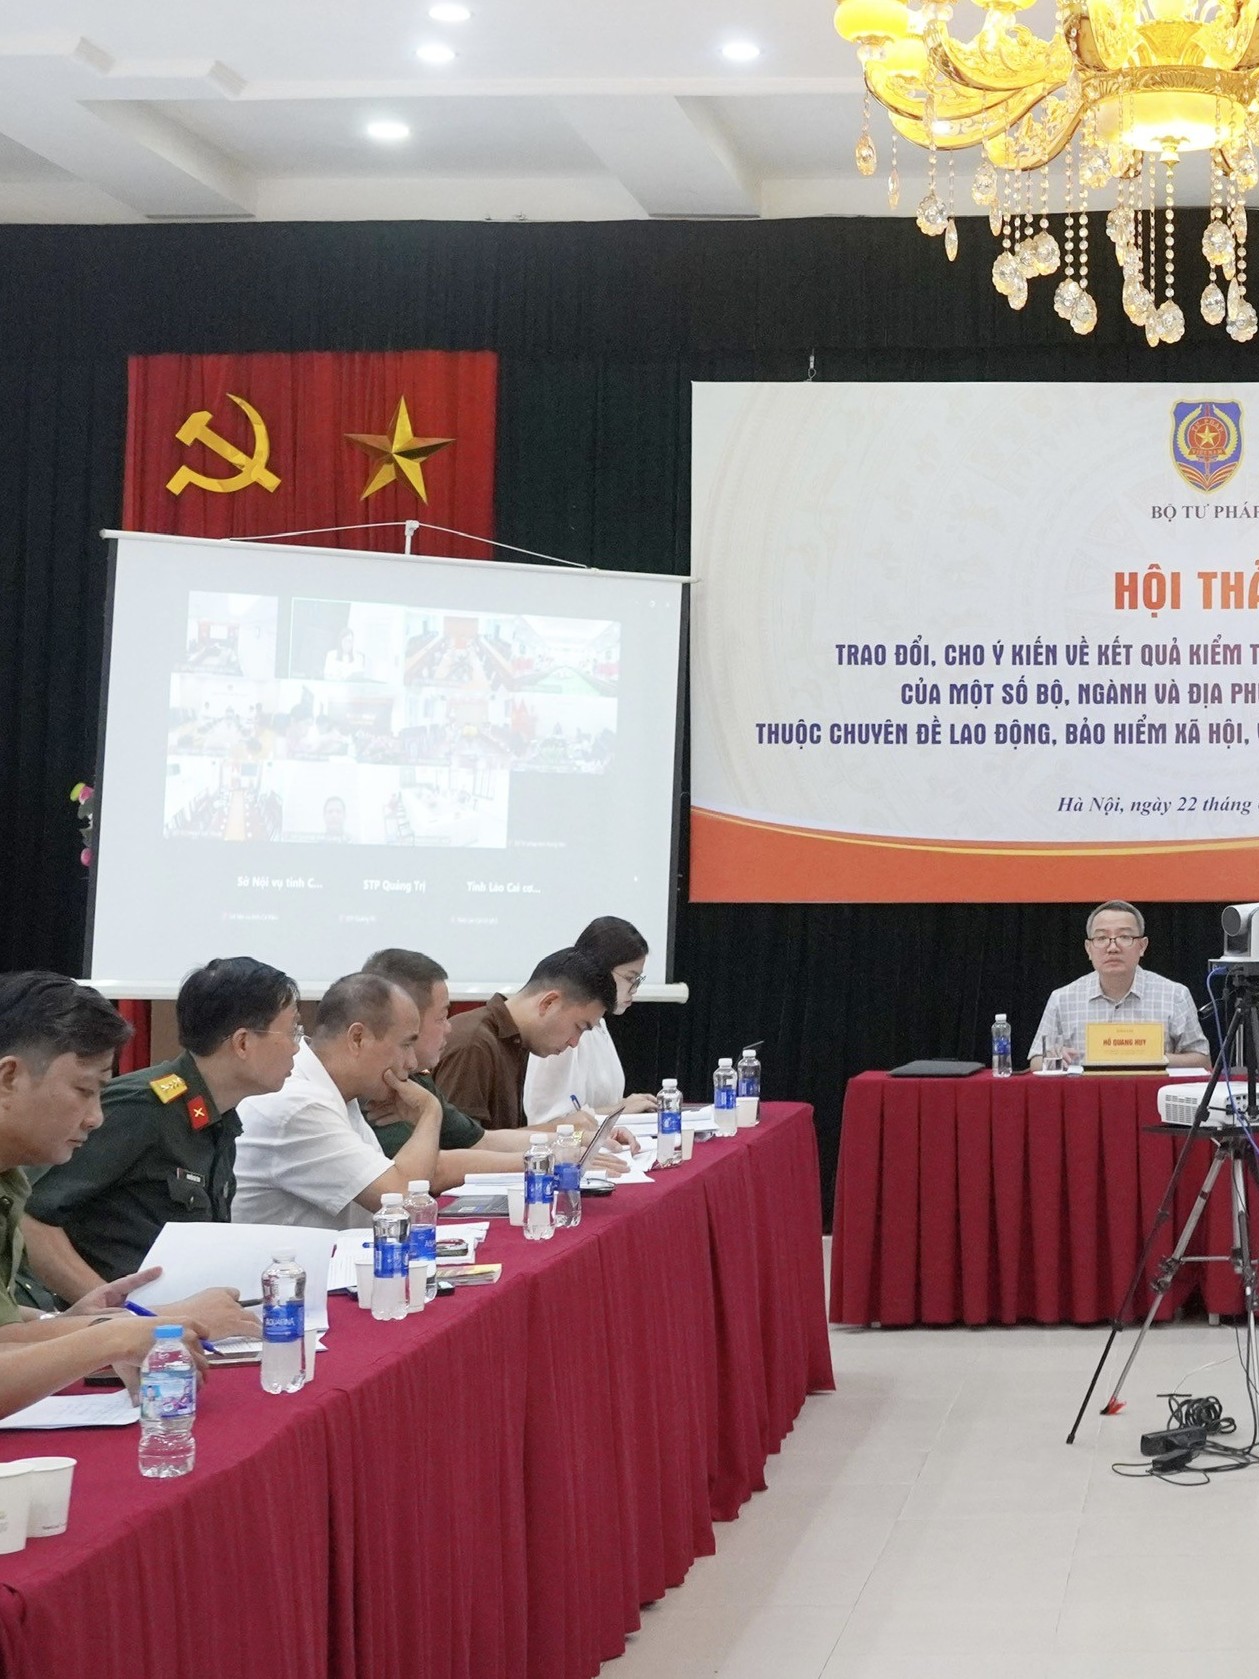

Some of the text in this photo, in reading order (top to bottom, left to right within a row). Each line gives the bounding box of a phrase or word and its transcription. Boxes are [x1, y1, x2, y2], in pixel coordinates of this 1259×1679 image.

[1151, 503, 1177, 523] BỘ
[1182, 503, 1210, 520] TƯ
[1114, 563, 1181, 619] HỘI
[836, 644, 886, 665] TRAO
[894, 635, 936, 668] ĐỔI,
[945, 644, 984, 665] CHO
[992, 638, 1004, 665] Ý
[1012, 636, 1057, 665] KIẾN
[1066, 636, 1089, 665] VỀ
[1098, 636, 1133, 665] KẾT
[1141, 637, 1180, 667] QUẢ
[1190, 634, 1241, 665] KIỂM
[901, 677, 940, 705] CỦA
[950, 679, 994, 709] MỘT
[1002, 675, 1028, 705] SỐ
[1037, 679, 1069, 709] BỘ,
[1078, 679, 1146, 705] NGÀNH
[1155, 679, 1180, 705] VÀ
[1188, 683, 1222, 708] ĐỊA
[756, 719, 821, 750] THUỘC
[830, 719, 907, 745] CHUYÊN
[916, 715, 942, 745] ĐỀ
[950, 724, 986, 745] LAO
[994, 719, 1056, 750] ĐỘNG,
[1066, 717, 1105, 745] BẢO
[1114, 714, 1166, 745] HIỂM
[1175, 719, 1200, 744] XÃ
[1209, 719, 1249, 749] HỘI,
[1057, 796, 1083, 812] Hà
[1088, 796, 1124, 816] Nội,
[1130, 797, 1171, 816] ngày
[1177, 796, 1198, 812] 22
[1203, 796, 1252, 816] tháng
[252, 876, 269, 890] Nội
[271, 879, 284, 891] vụ
[363, 880, 381, 891] STP
